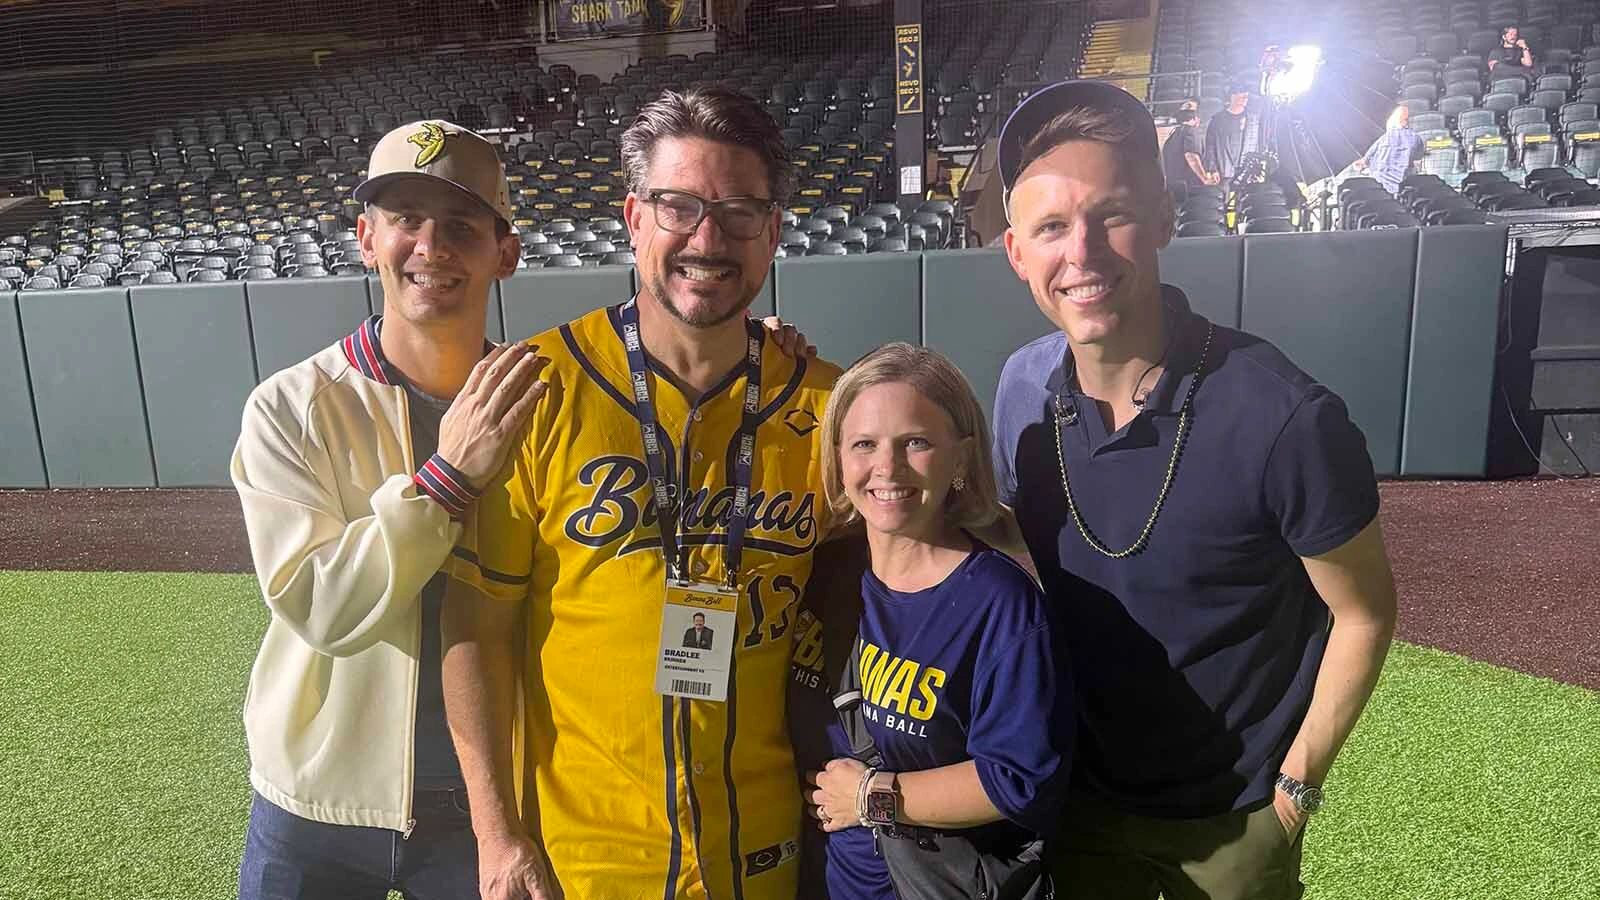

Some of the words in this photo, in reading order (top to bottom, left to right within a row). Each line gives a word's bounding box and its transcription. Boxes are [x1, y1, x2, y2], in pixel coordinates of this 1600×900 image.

[571, 4, 614, 24] SHARK
[616, 0, 650, 18] TANK
[743, 573, 802, 650] 13
[664, 648, 700, 659] BRADLEE
[885, 714, 928, 738] BALL
